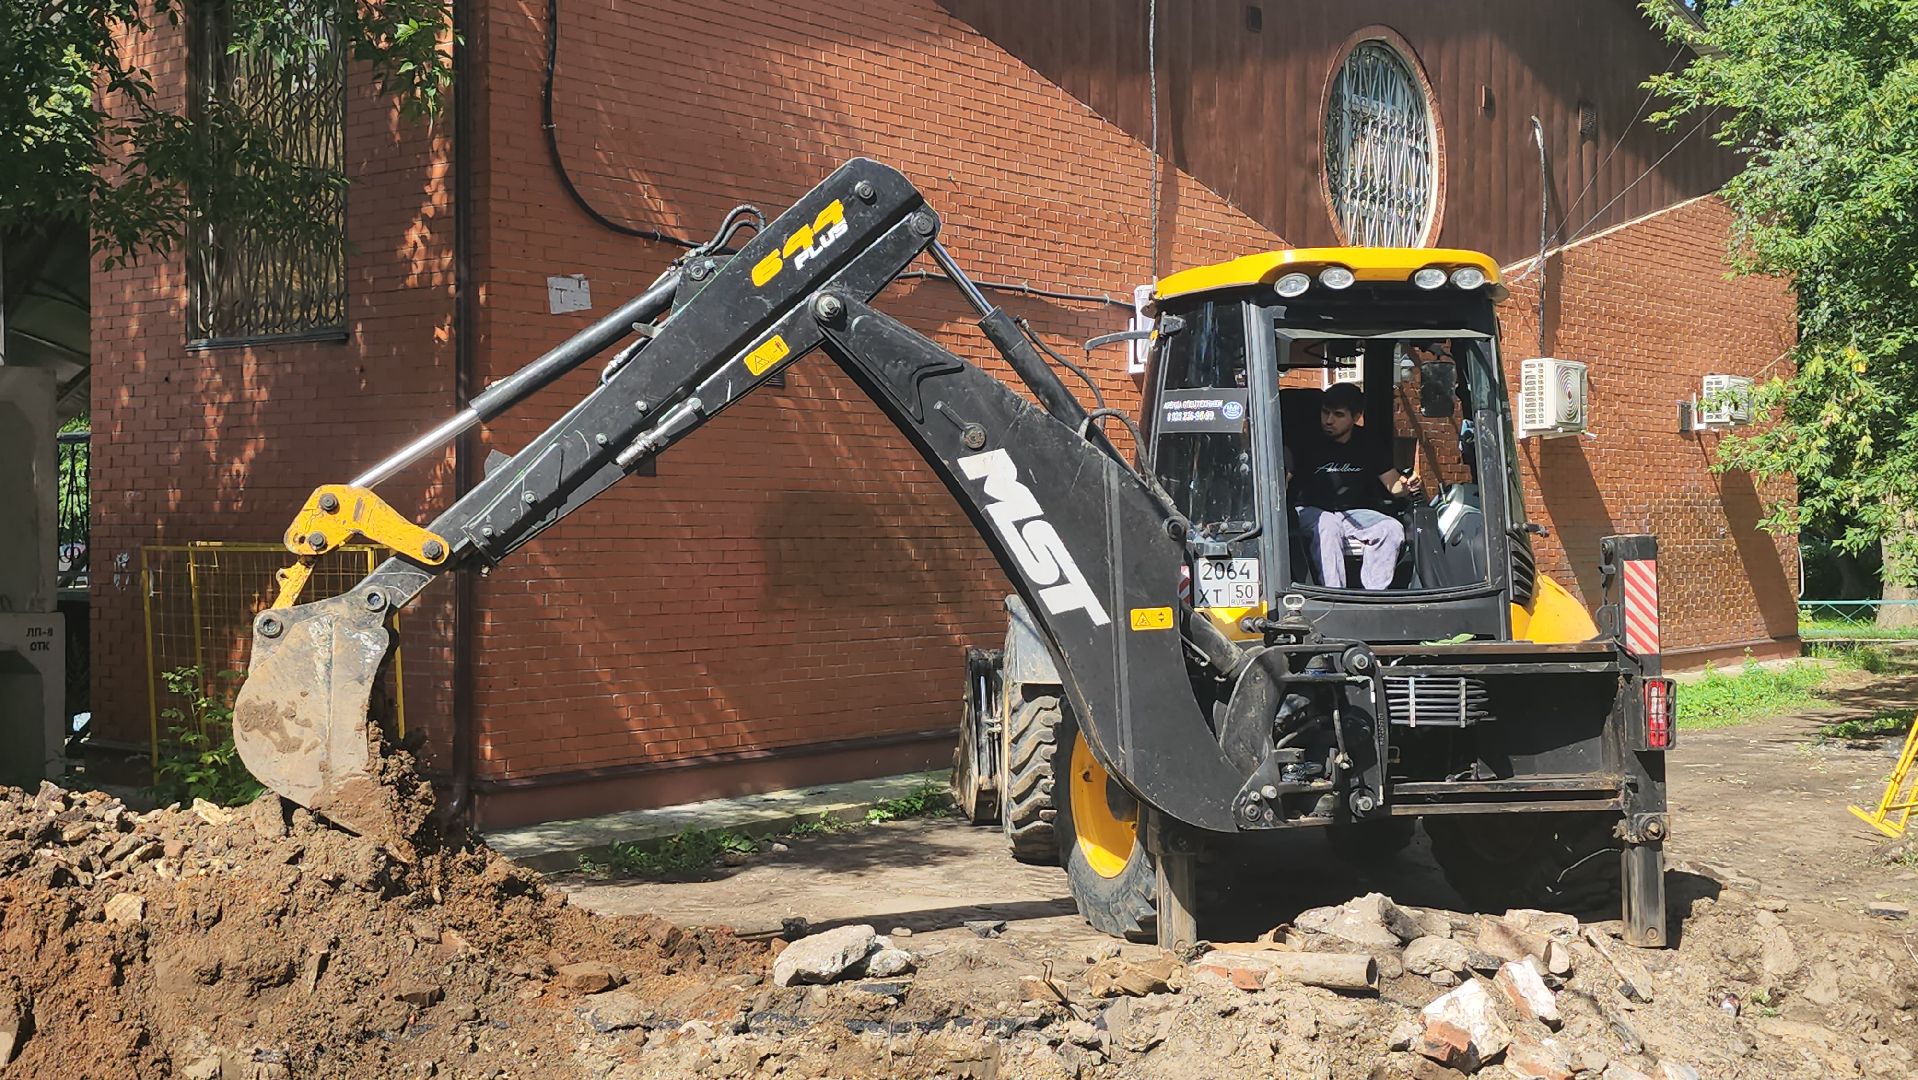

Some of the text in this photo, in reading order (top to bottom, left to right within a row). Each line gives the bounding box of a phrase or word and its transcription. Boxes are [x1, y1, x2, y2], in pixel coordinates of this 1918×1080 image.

[751, 198, 845, 288] 644
[794, 217, 849, 271] PLUS
[956, 448, 1112, 627] MST
[1202, 562, 1250, 580] 2064
[1235, 584, 1254, 599] 50
[30, 641, 50, 651] ОТК
